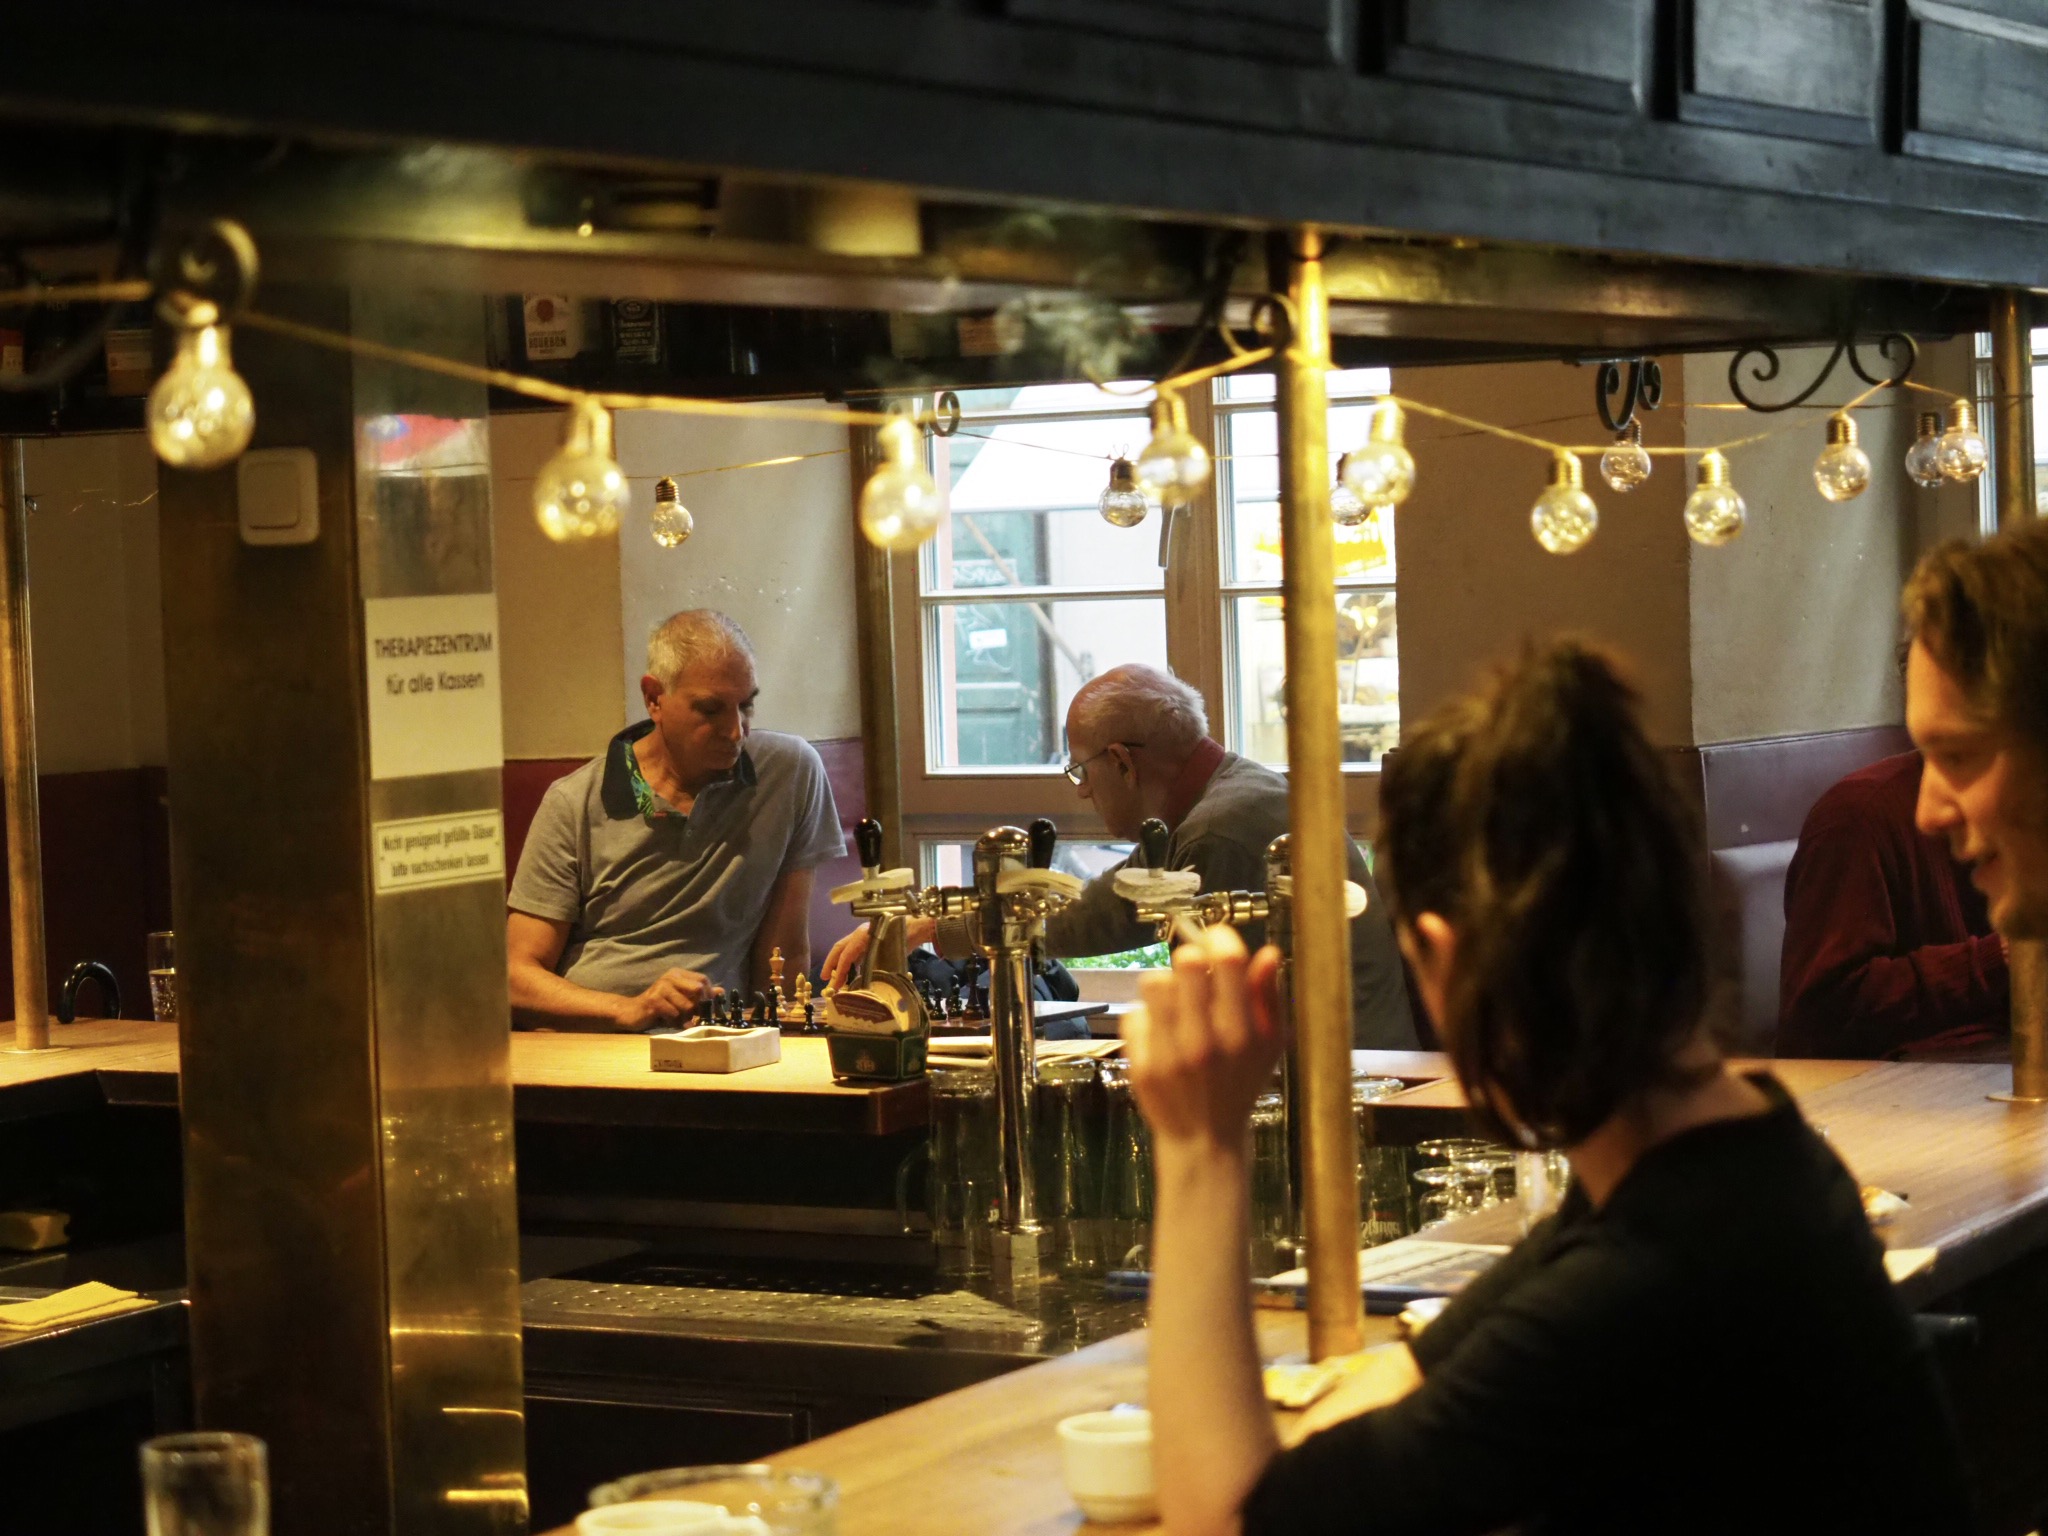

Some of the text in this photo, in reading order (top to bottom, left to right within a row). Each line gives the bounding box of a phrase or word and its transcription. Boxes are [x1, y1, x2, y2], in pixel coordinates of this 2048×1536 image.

[375, 633, 492, 657] THERAPIEZENTRUM
[385, 672, 484, 695] für alle Kassen
